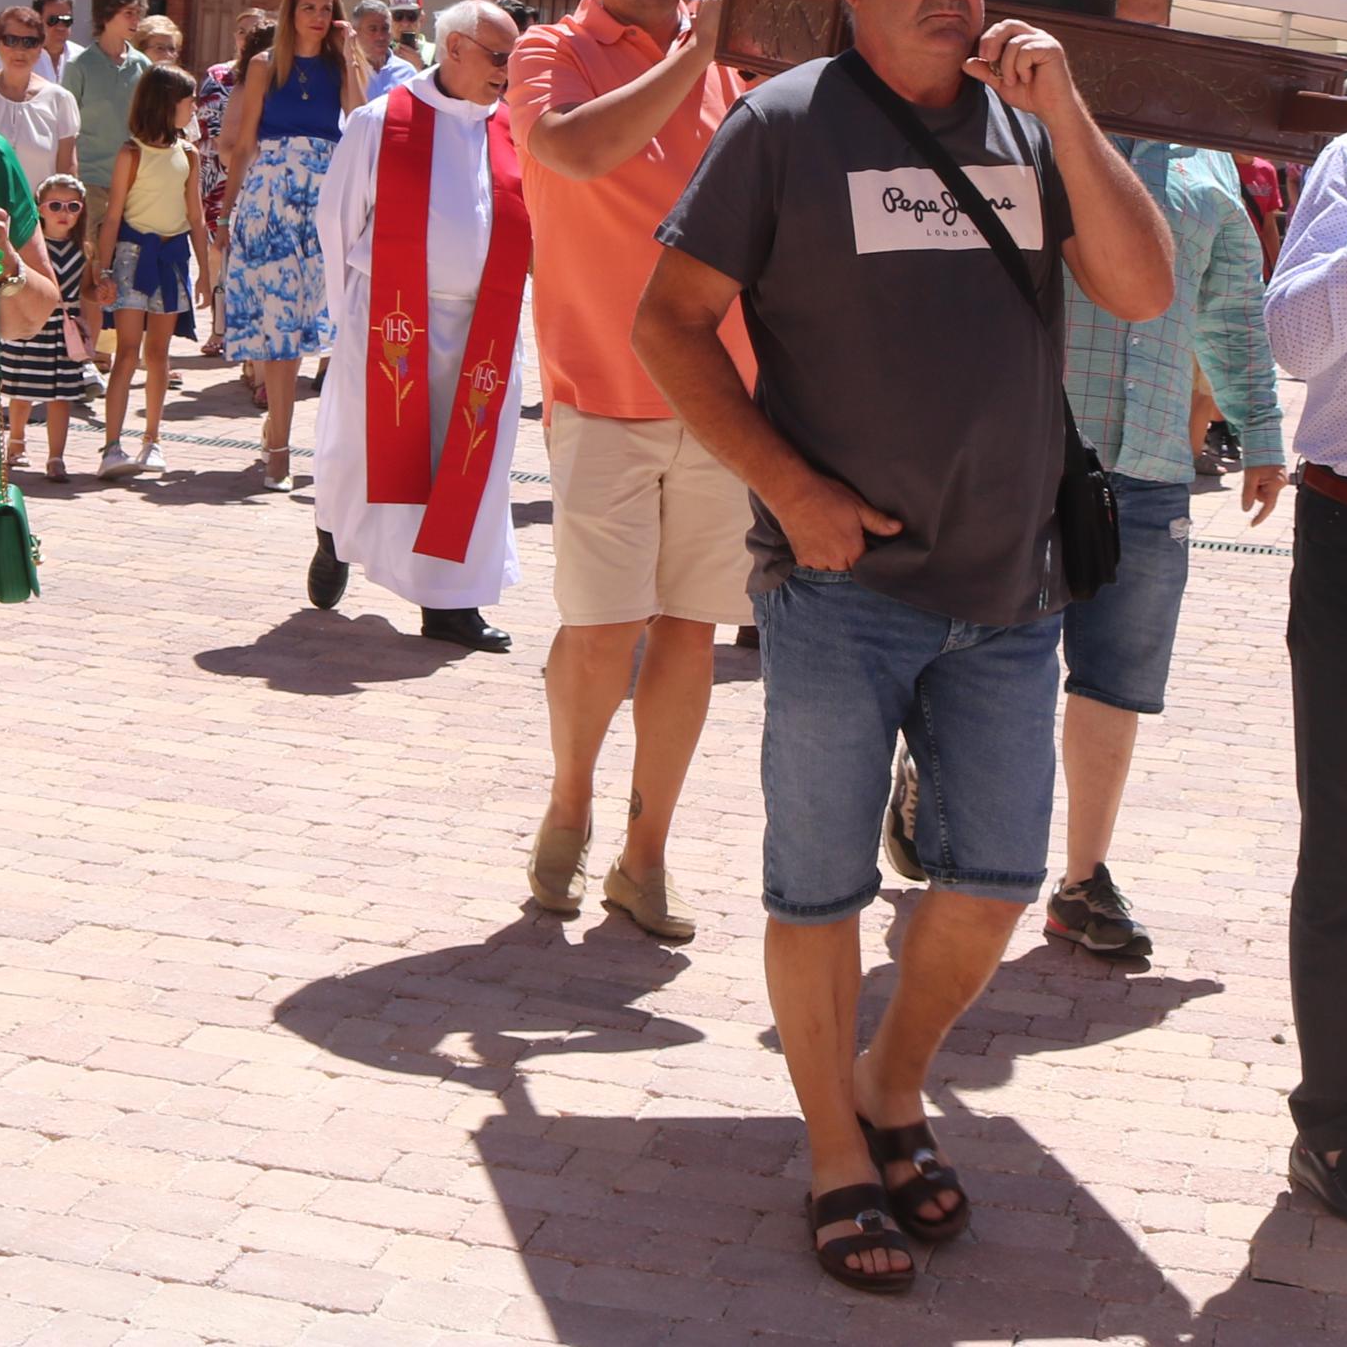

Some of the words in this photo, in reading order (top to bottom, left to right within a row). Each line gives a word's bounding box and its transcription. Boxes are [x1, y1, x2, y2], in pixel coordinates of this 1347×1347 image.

[882, 187, 940, 223] Pepe
[926, 228, 979, 238] LONDON
[386, 318, 411, 342] IHS
[474, 365, 498, 392] IHS
